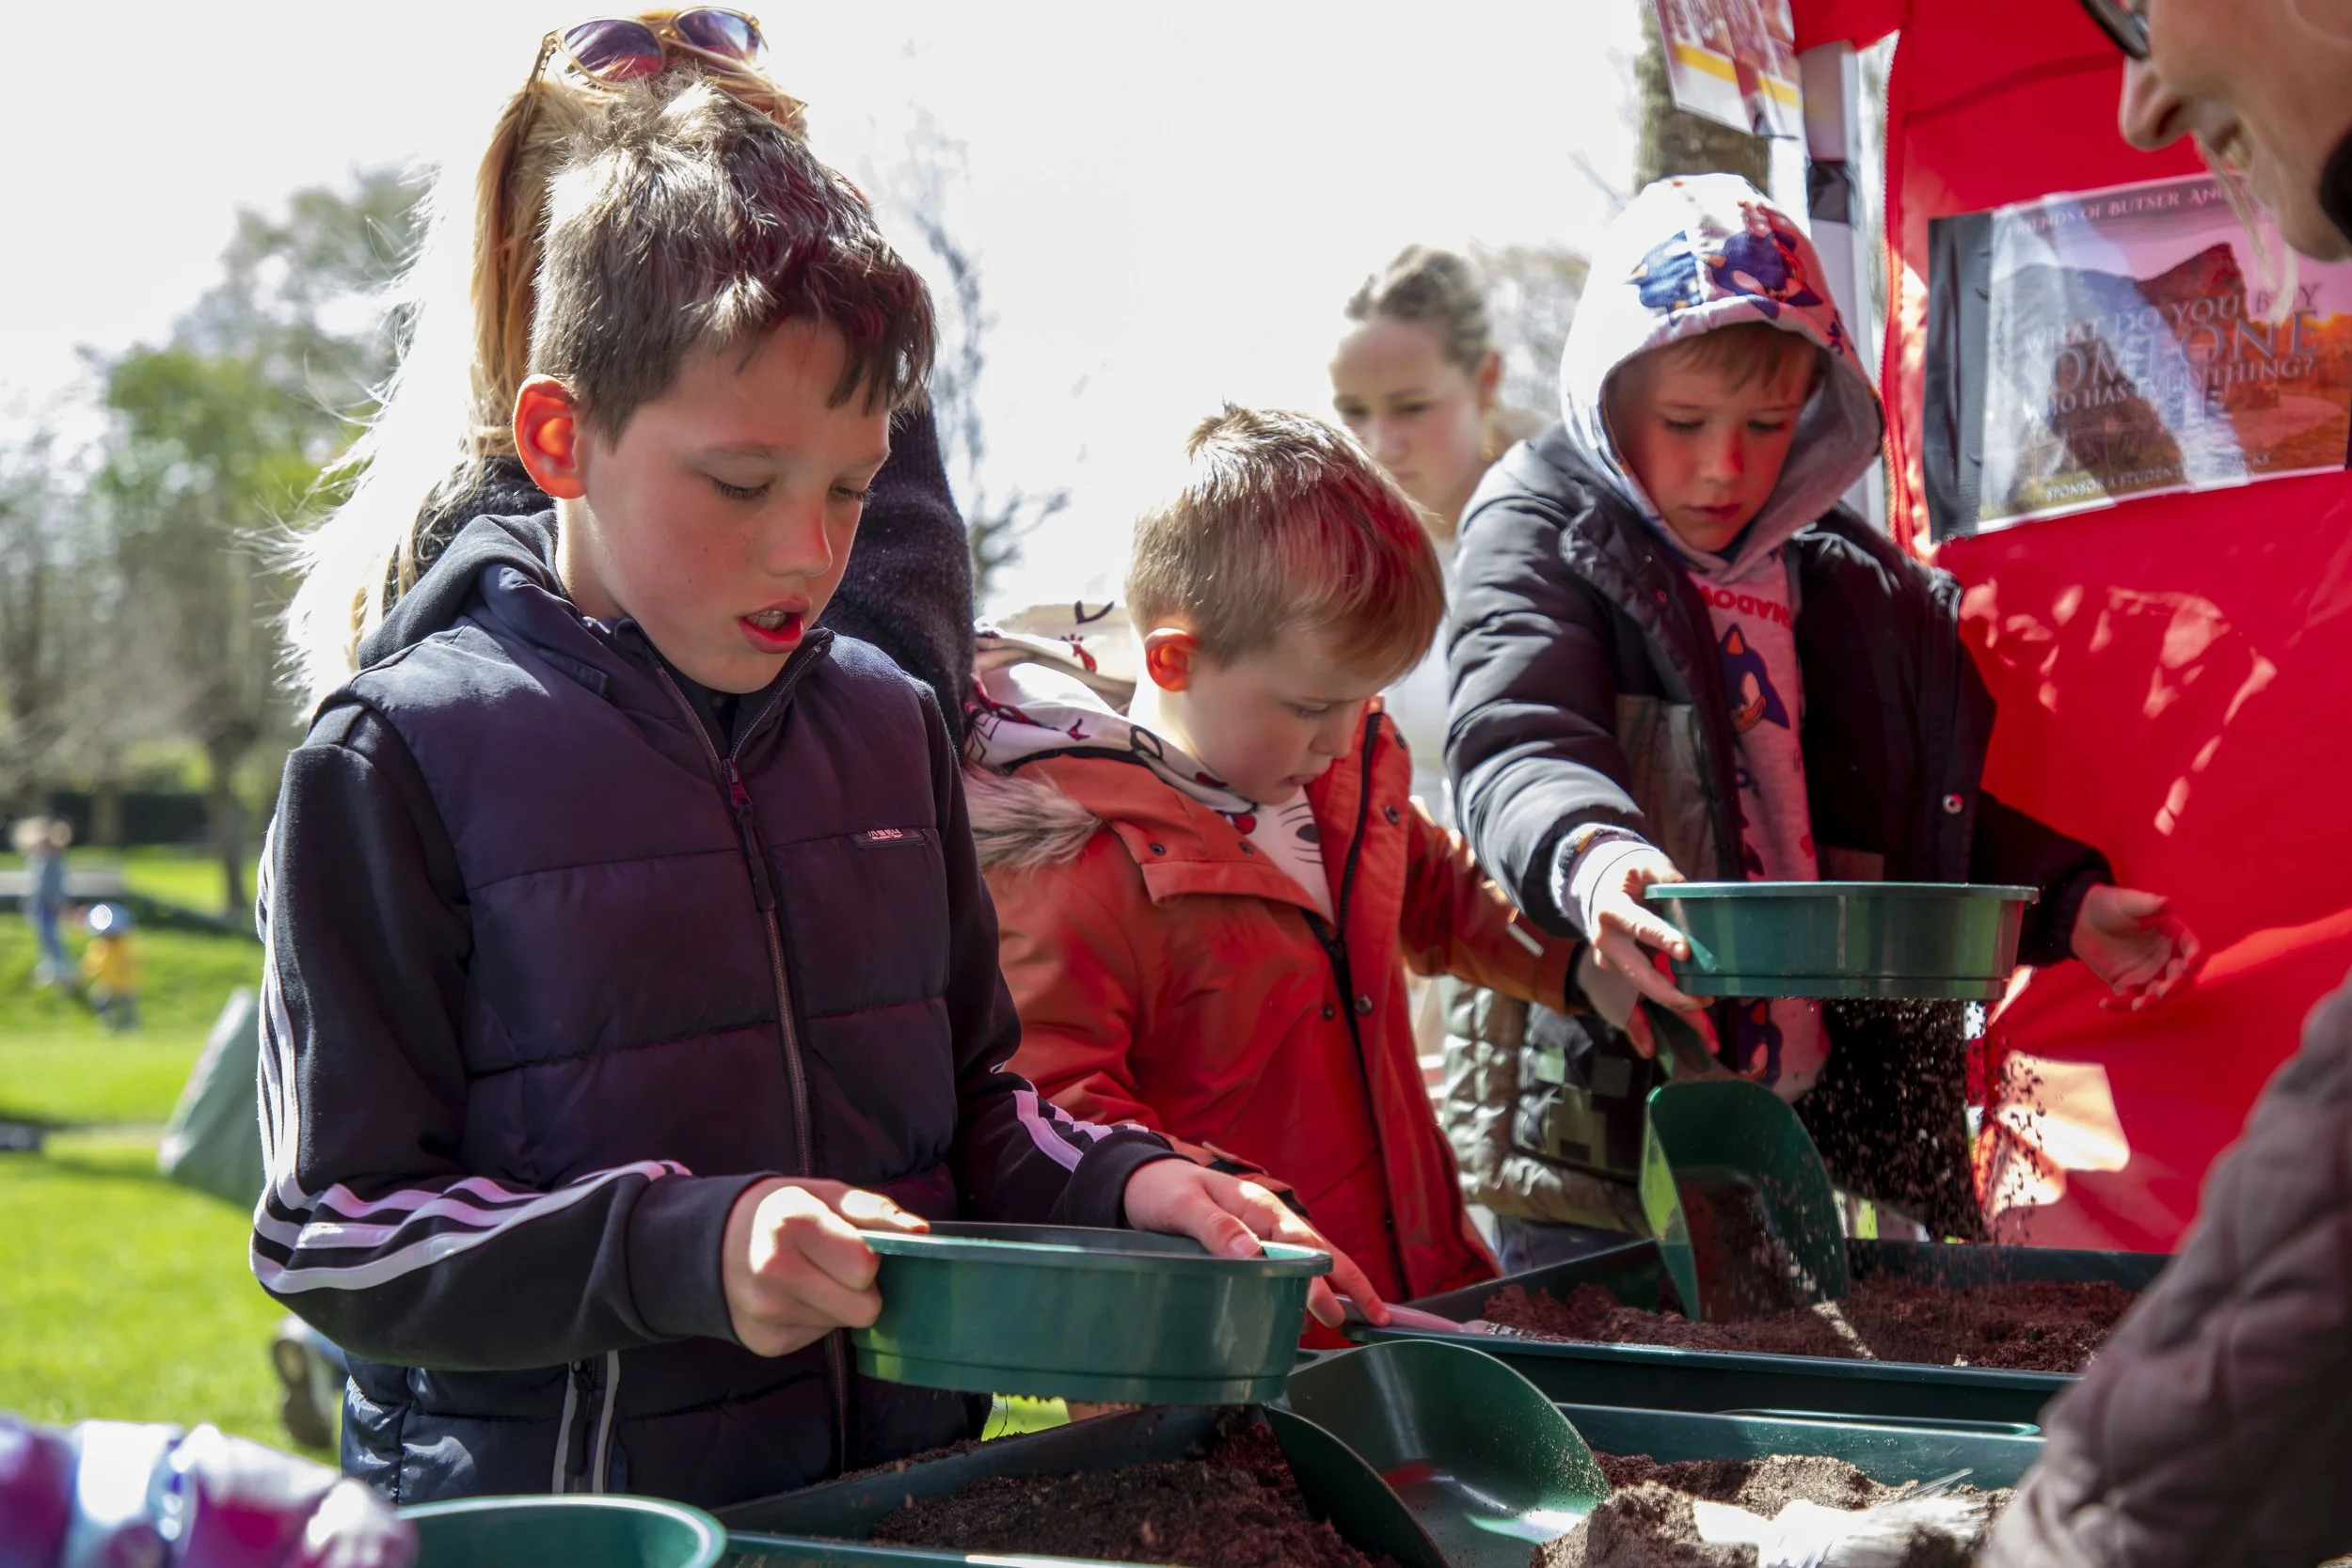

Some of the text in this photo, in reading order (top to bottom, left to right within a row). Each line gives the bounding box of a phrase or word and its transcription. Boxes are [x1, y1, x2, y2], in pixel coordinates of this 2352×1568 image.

[2080, 204, 2101, 221] OF
[2107, 191, 2180, 216] BUTSER
[2115, 306, 2161, 335] DO
[2170, 294, 2240, 324] YOU
[2256, 284, 2319, 312] BY
[2085, 387, 2127, 409] HAS
[2046, 477, 2105, 502] SPONSOR
